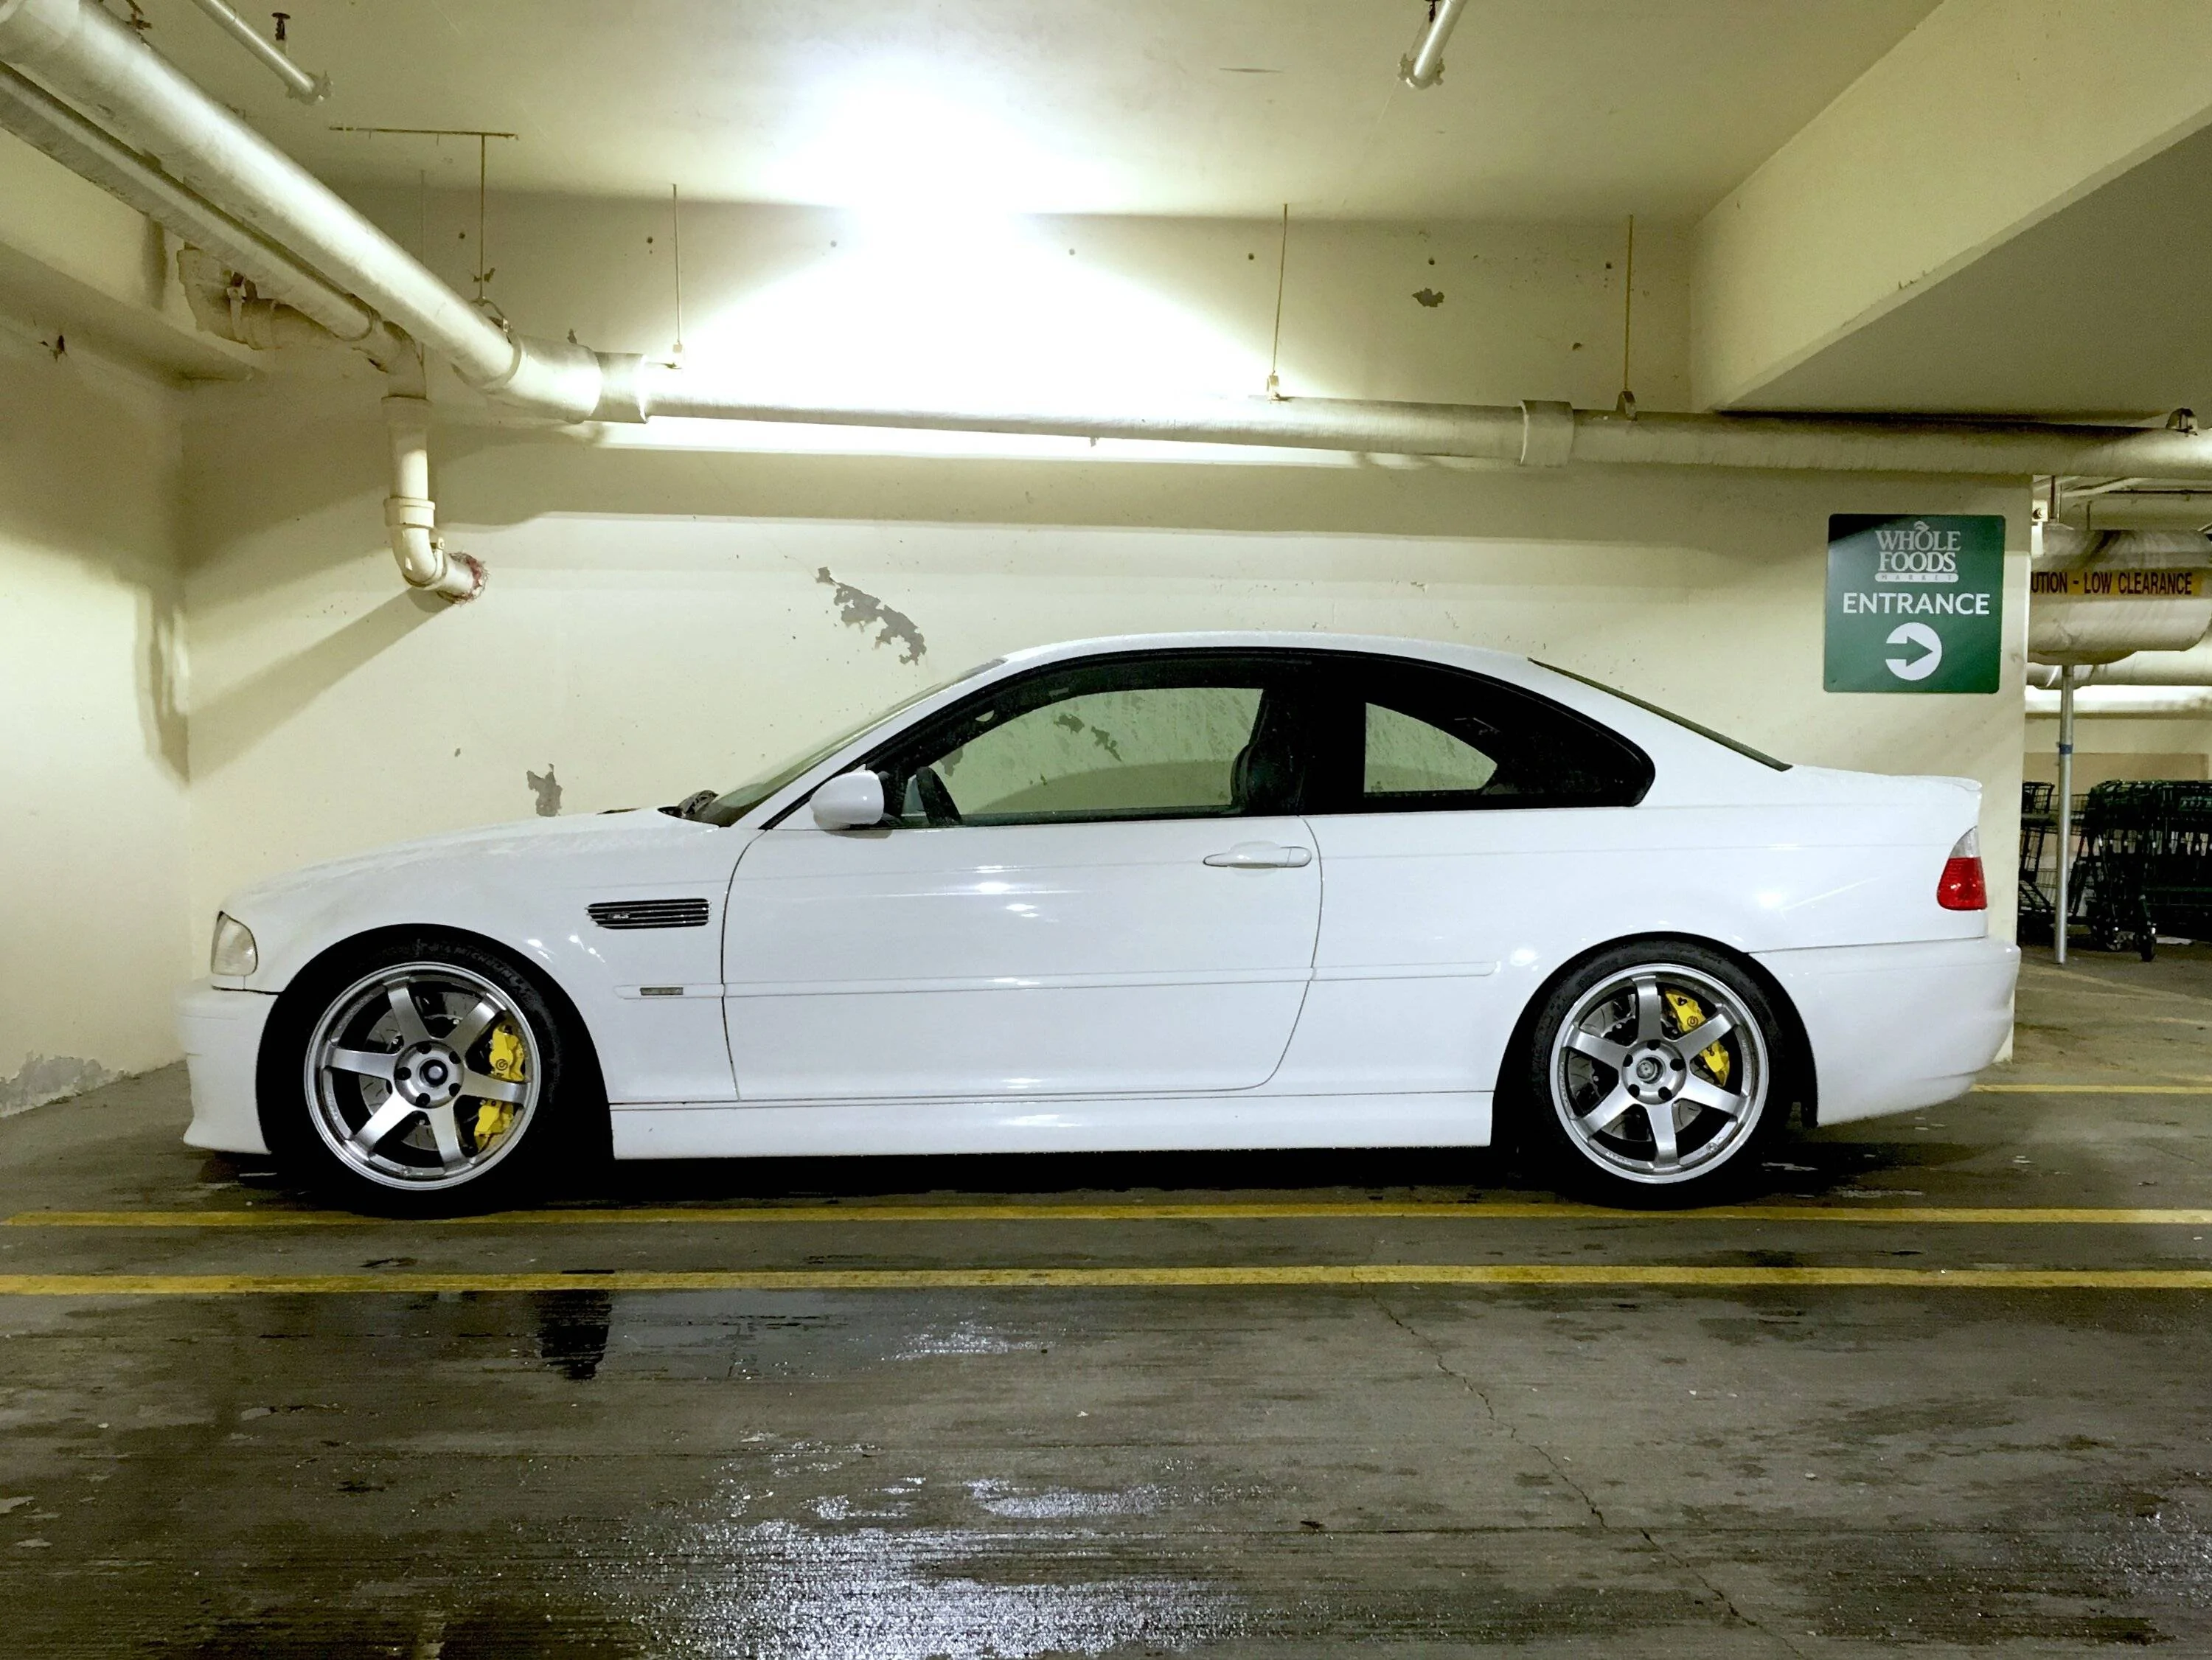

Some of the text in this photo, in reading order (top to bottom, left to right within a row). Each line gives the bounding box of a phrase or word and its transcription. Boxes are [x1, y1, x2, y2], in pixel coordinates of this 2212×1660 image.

[1875, 528, 1961, 552] WHOLE
[1878, 552, 1956, 572] FOODS
[2031, 572, 2067, 594] UTION
[2084, 572, 2112, 594] LOW
[2118, 572, 2193, 594] CLEARANCE
[1843, 592, 1991, 615] ENTRANCE
